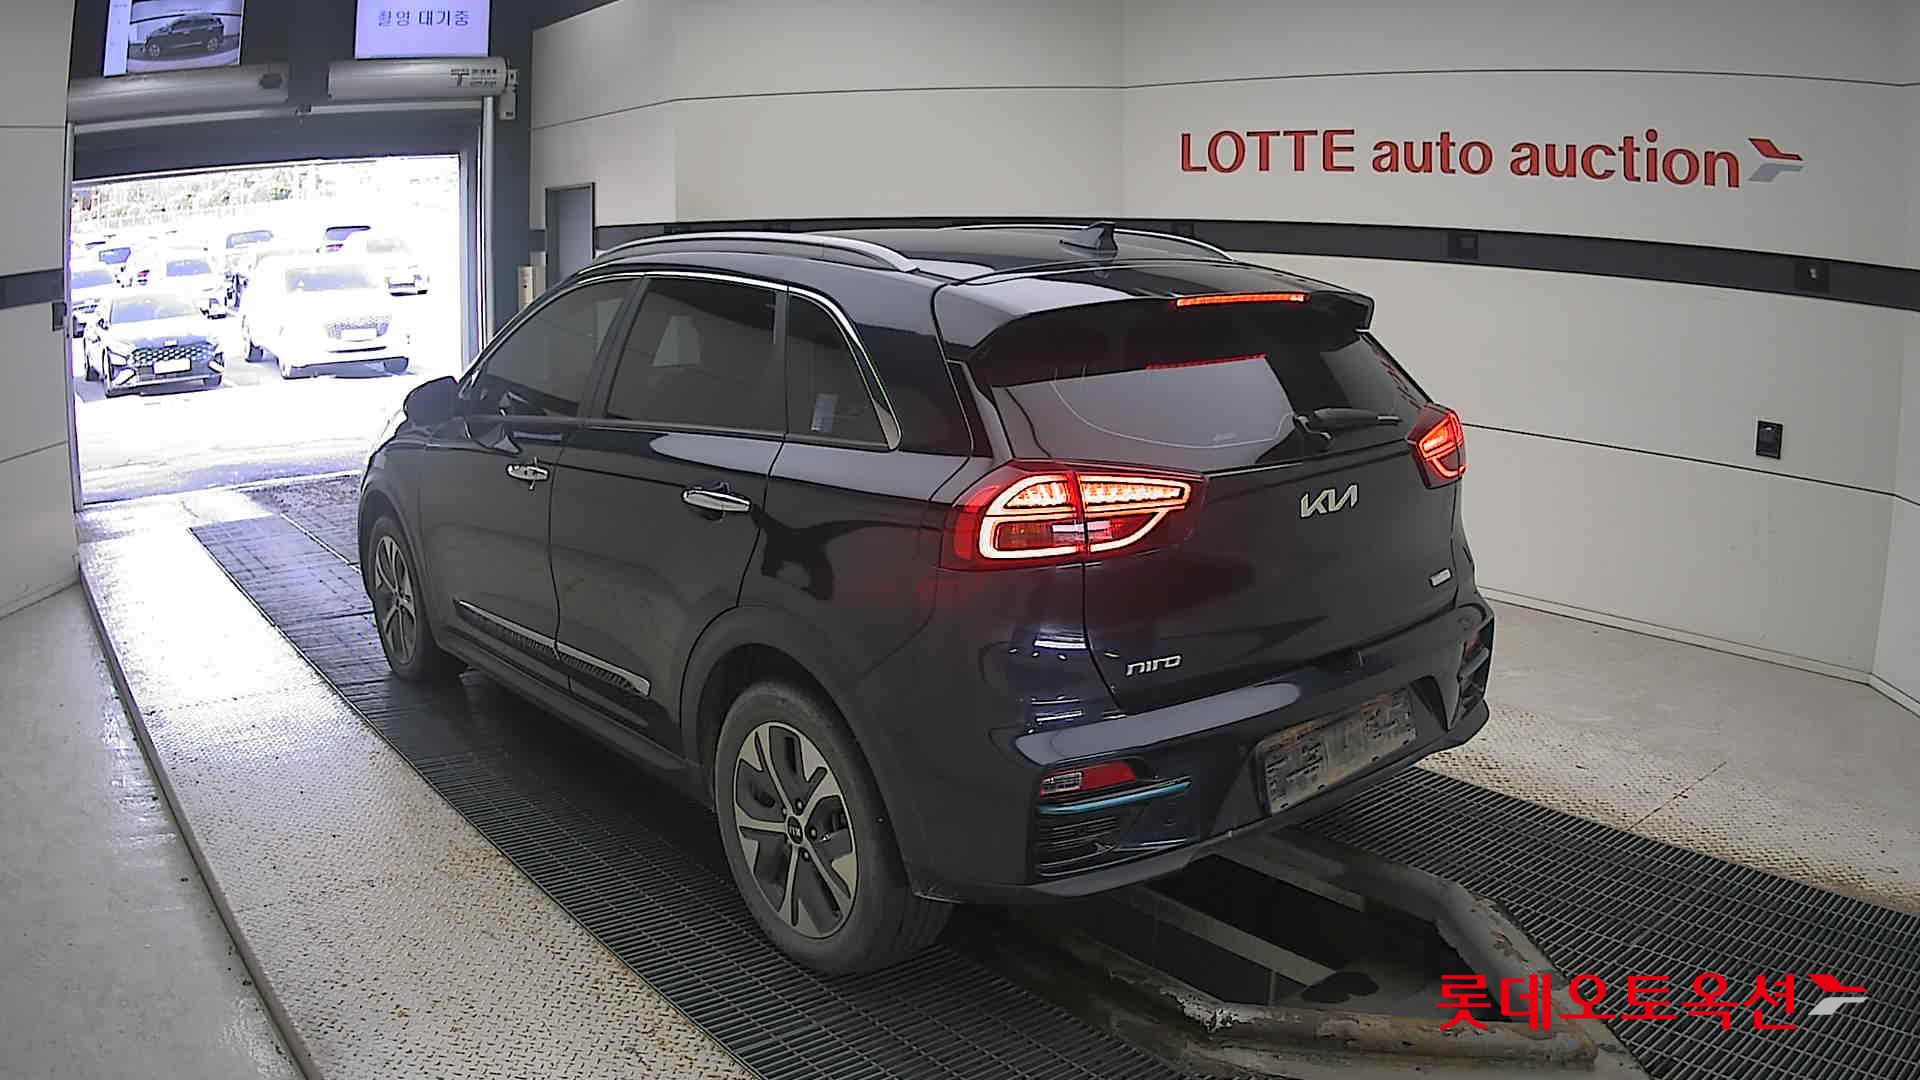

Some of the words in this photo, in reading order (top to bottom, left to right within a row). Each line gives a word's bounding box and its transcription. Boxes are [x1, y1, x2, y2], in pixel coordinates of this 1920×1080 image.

[418, 10, 470, 26] 대기중
[1180, 128, 1355, 173] LOTTE
[1371, 131, 1494, 176] auto
[1510, 128, 1742, 189] auction
